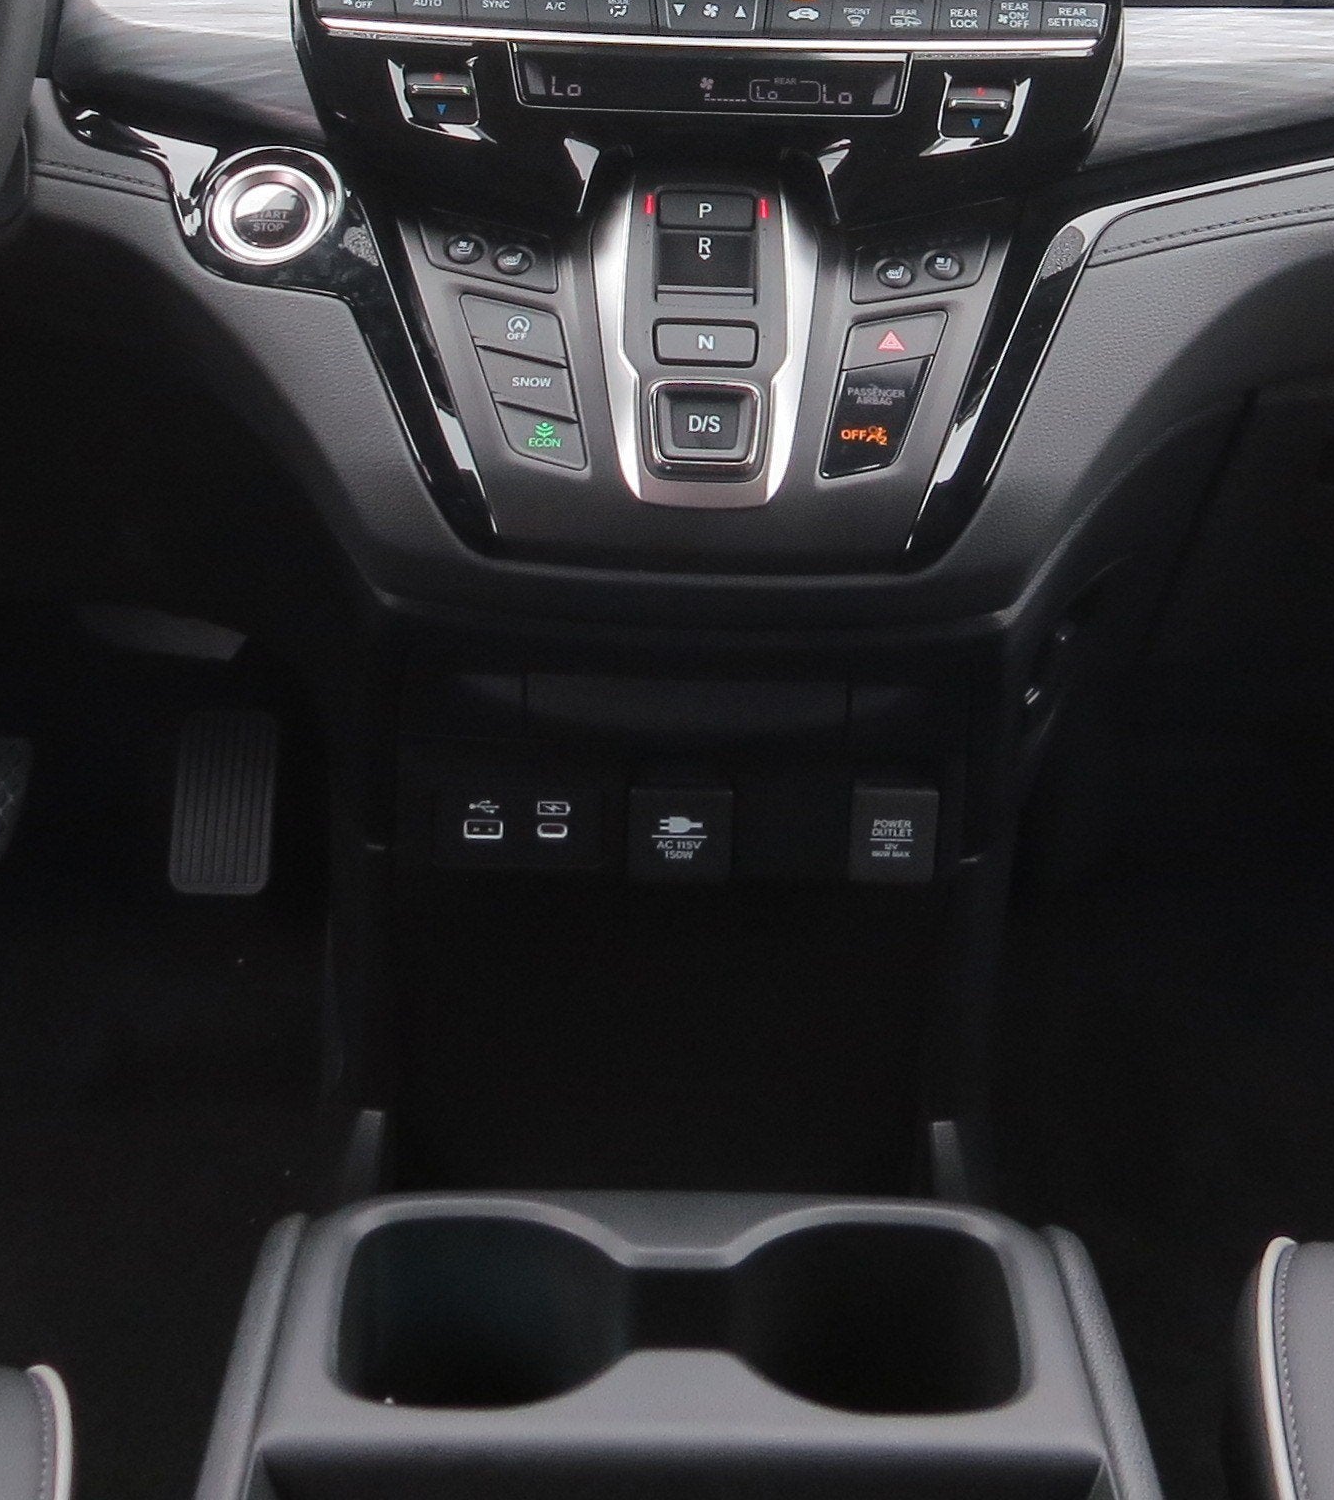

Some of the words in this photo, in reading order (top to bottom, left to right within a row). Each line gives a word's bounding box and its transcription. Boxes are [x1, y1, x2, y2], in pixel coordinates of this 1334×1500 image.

[354, 0, 373, 9] OFF
[482, 0, 510, 9] SYNC
[545, 1, 566, 11] A/C
[1000, 2, 1029, 11] REAR
[843, 7, 870, 15] FRONT
[895, 8, 917, 16] REAR
[950, 8, 978, 18] REAR
[1009, 11, 1030, 20] ON/
[1058, 7, 1087, 16] REAR
[950, 18, 979, 29] LOCK
[1009, 19, 1029, 29] OFF
[1047, 17, 1099, 28] SETTINGS
[551, 75, 581, 97] Lo
[774, 77, 797, 85] REAR
[756, 85, 778, 100] Lo
[823, 84, 853, 105] Lo
[252, 210, 288, 220] START
[698, 202, 713, 219] P
[252, 222, 285, 233] STOP
[698, 236, 712, 254] R
[507, 332, 528, 341] OFF
[698, 335, 715, 350] N
[511, 377, 551, 388] SNOW
[847, 387, 906, 398] PASSENGER
[856, 396, 893, 406] AIRBAG
[688, 415, 721, 434] D/S
[840, 429, 867, 440] OFF
[528, 437, 561, 448] ECON
[873, 819, 912, 829] POWER
[872, 828, 914, 838] OUTLET
[656, 840, 674, 850] AC
[676, 840, 702, 850] 115V
[665, 850, 694, 860] 150W
